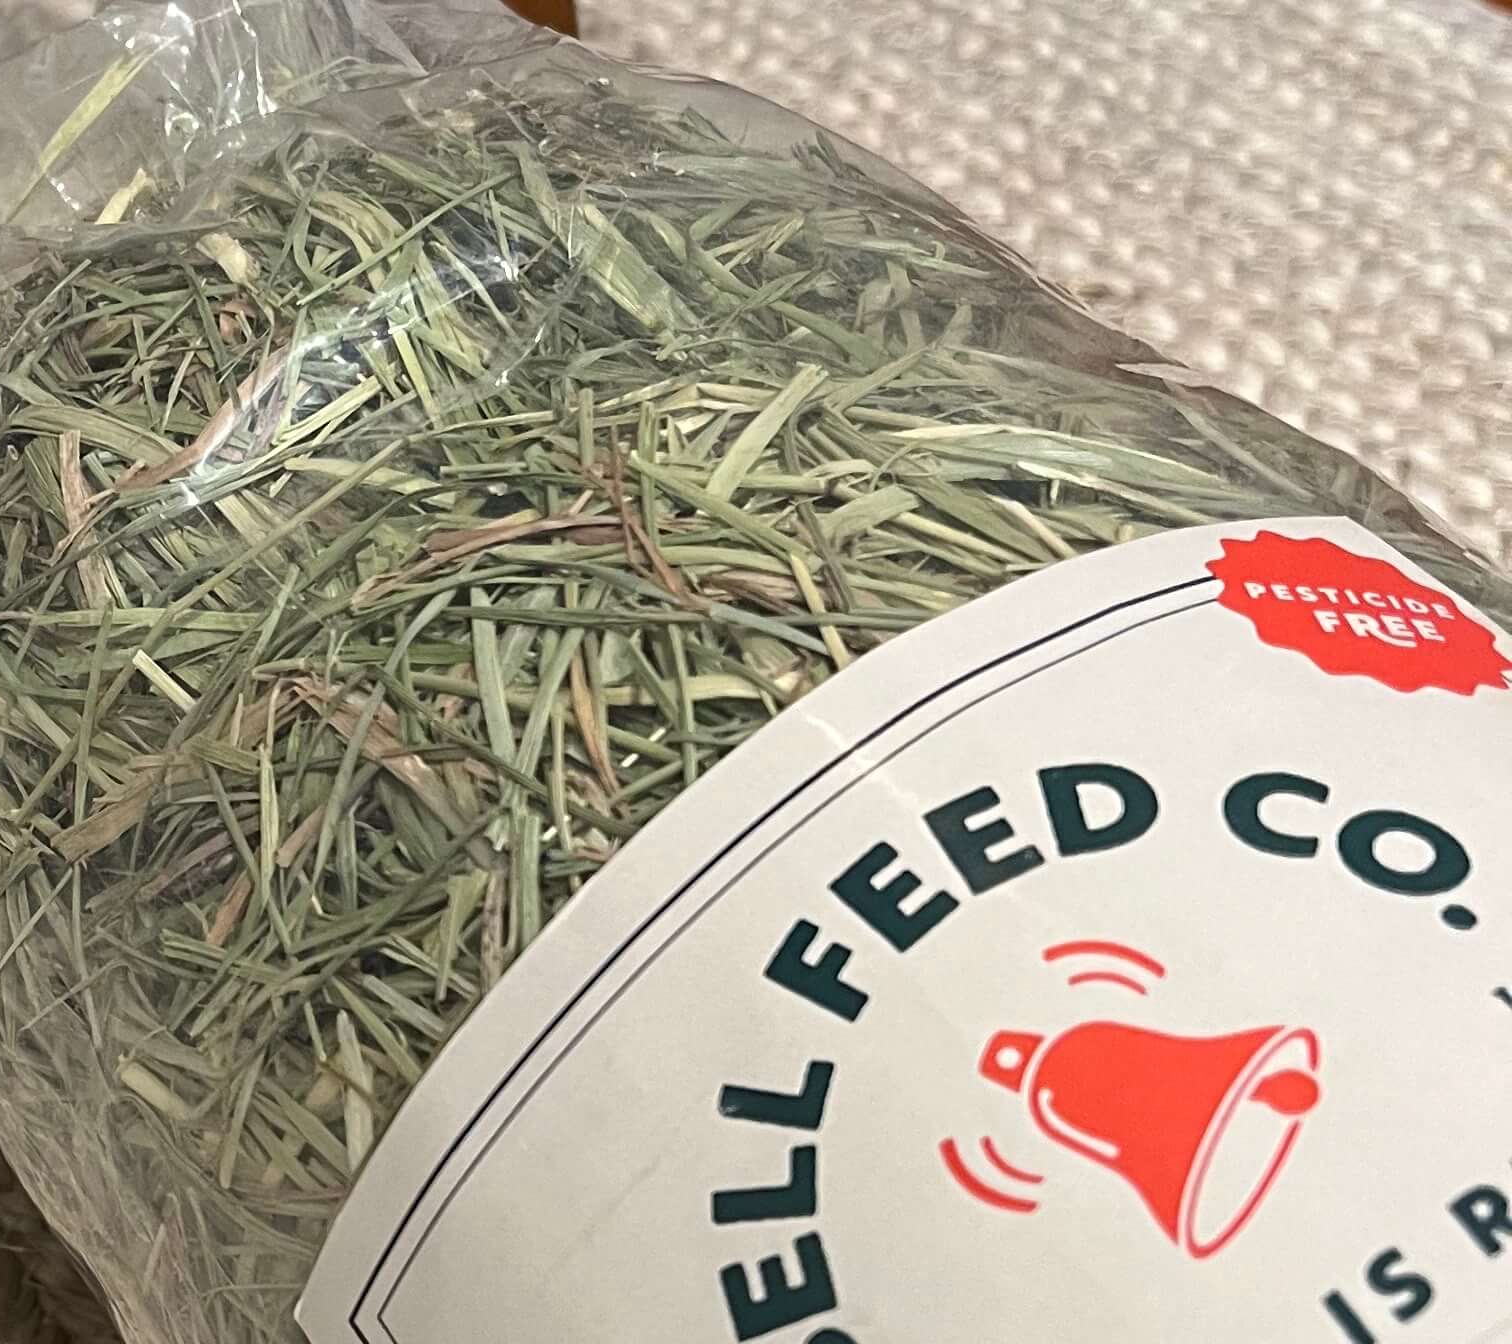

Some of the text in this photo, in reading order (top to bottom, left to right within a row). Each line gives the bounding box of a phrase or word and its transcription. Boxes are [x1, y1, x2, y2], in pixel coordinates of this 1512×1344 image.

[1243, 581, 1457, 621] PESTICIDE
[1313, 610, 1446, 648] FREE
[763, 762, 1160, 1023] FEED
[1223, 772, 1478, 931] CO.
[1446, 1159, 1512, 1257] R
